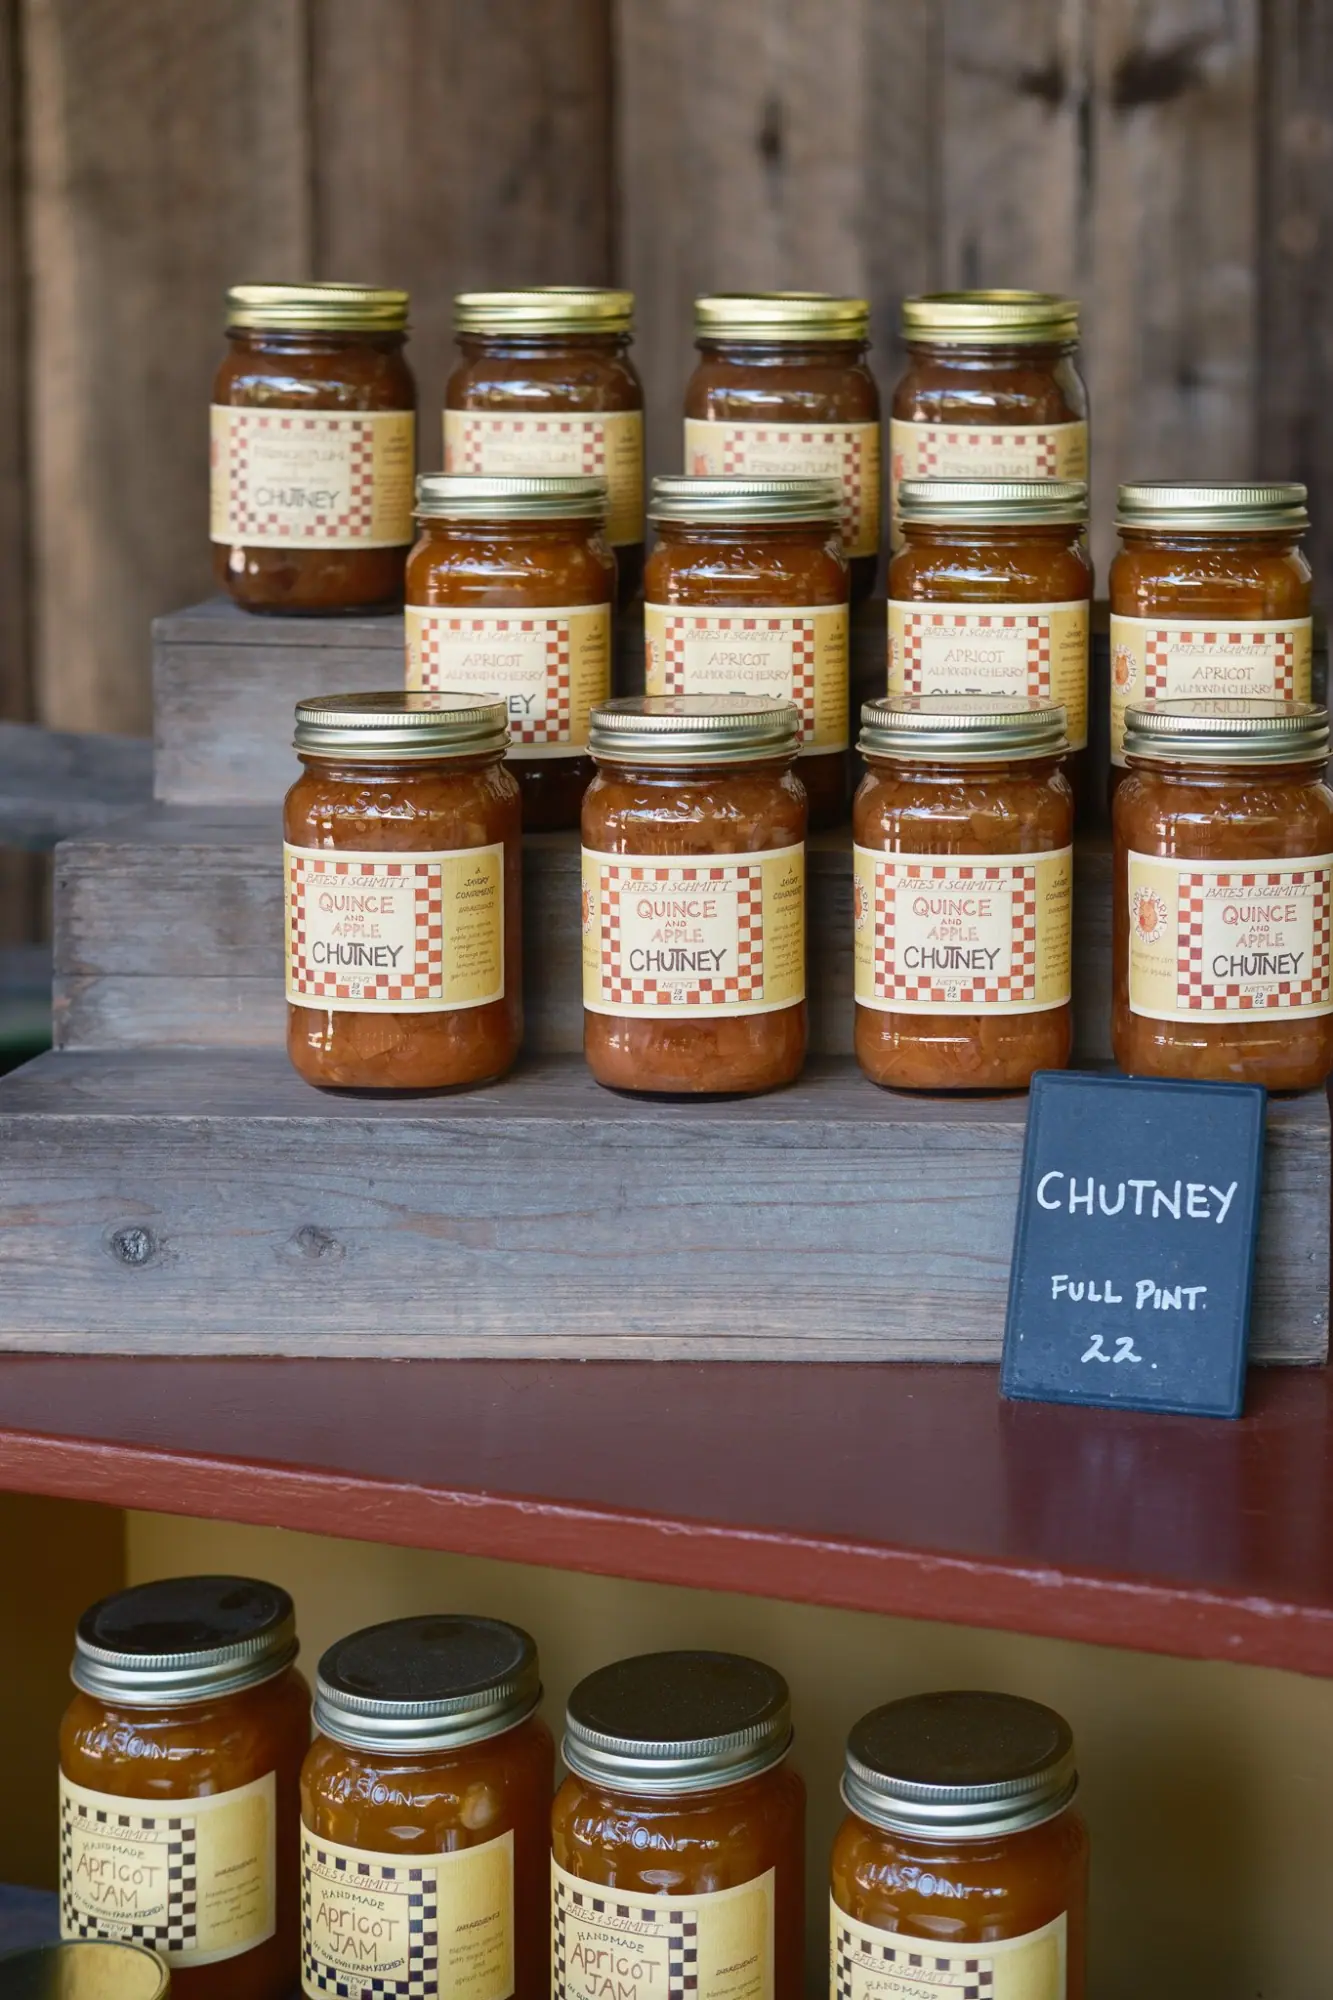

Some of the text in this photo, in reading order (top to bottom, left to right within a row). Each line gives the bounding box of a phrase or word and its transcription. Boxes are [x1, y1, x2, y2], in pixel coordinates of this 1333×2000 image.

[255, 487, 340, 509] CHUTNEY
[462, 654, 524, 667] APRICOT
[708, 652, 770, 666] APRICOT
[944, 649, 1005, 663] APRICOT
[743, 669, 790, 681] CHERRY
[978, 667, 1025, 678] CHERRY
[1192, 666, 1255, 680] APRICOT
[1227, 684, 1273, 695] CHERRY
[305, 873, 339, 886] BATES
[348, 876, 410, 889] SCHMITT
[621, 880, 658, 892] BATES
[668, 880, 733, 892] SCHMITT
[897, 878, 935, 890] BATES
[945, 880, 1008, 891] SCHMITT
[1205, 887, 1244, 898] BATES
[1254, 885, 1311, 897] SCHMITT
[318, 892, 395, 914] QUINCE
[637, 899, 718, 920] QUINCE
[912, 896, 992, 918] QUINCE
[941, 918, 962, 926] AND
[1222, 904, 1298, 926] QUINCE
[331, 923, 382, 939] APPLE
[651, 929, 704, 943] APPLE
[927, 926, 980, 942] APPLE
[1236, 932, 1285, 948] APPLE
[312, 941, 404, 968] CHUTNEY
[630, 948, 728, 972] CHUTNEY
[904, 946, 1001, 970] CHUTNEY
[1212, 952, 1304, 978] CHUTNEY
[1036, 1170, 1239, 1224] CHUTNEY
[1051, 1274, 1123, 1304] FULL
[82, 1841, 146, 1860] HANDMADE
[345, 1874, 404, 1893] SCHMITT
[90, 1880, 138, 1909] JAM
[321, 1889, 385, 1911] HANDMADE
[565, 1901, 595, 1921] BATES
[603, 1916, 664, 1935] SCHMITT
[329, 1930, 377, 1962] JAM
[577, 1931, 645, 1954] HANDMADE
[352, 1962, 372, 1972] FARM
[894, 1965, 958, 1984] SCHMITT
[585, 1972, 637, 2000] JAM
[865, 1979, 939, 2000] HANDMADE
